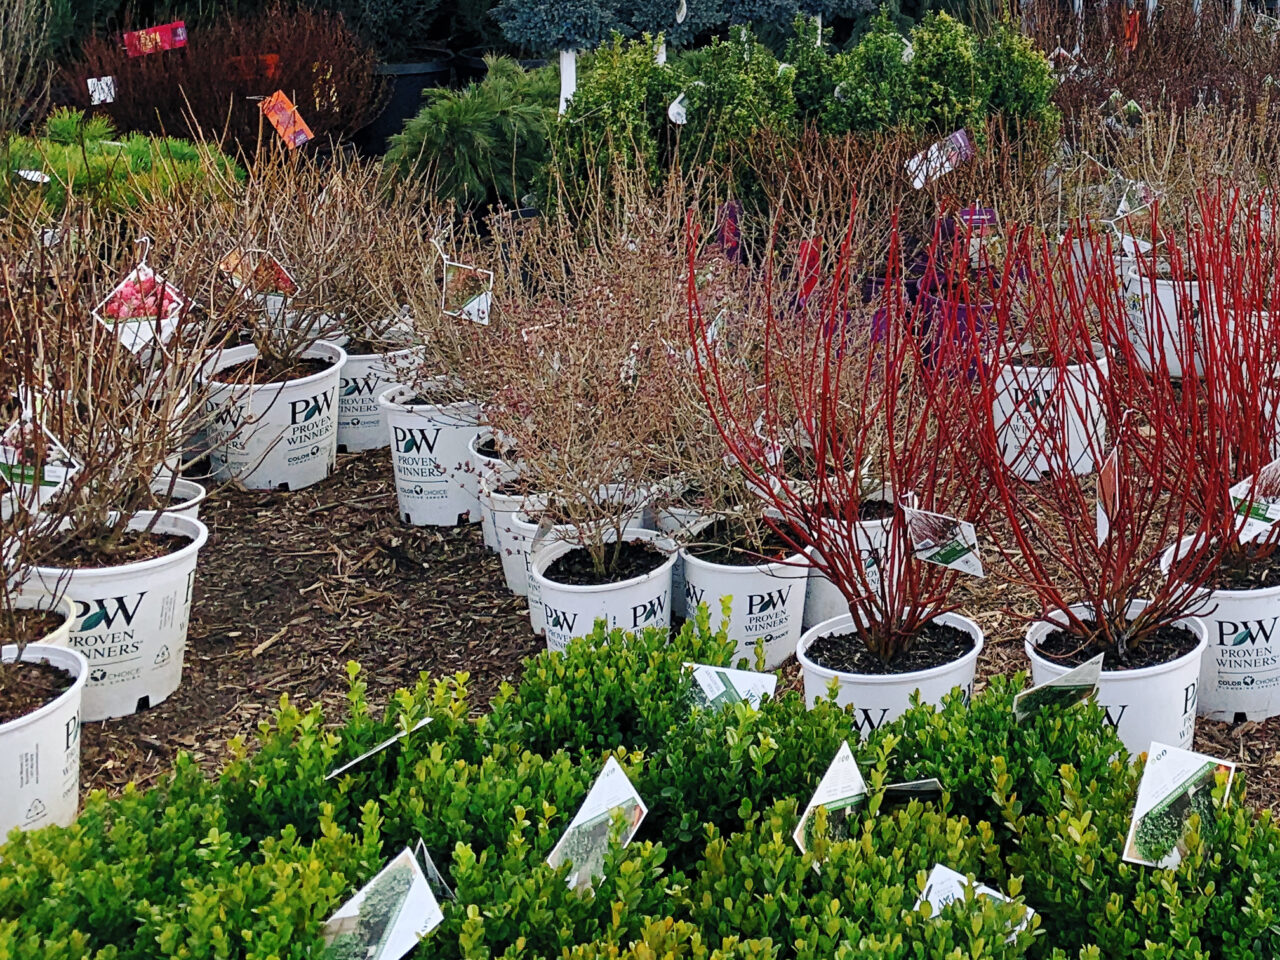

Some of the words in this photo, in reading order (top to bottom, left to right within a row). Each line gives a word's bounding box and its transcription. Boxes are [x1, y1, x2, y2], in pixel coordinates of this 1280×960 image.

[287, 386, 335, 426] PW
[339, 405, 379, 413] INNERS
[392, 425, 442, 455] PW
[398, 455, 438, 467] PROVEN
[746, 584, 792, 616] PW
[544, 602, 578, 634] PW
[631, 590, 667, 629] PW
[749, 609, 787, 624] PROVEN
[745, 615, 791, 632] WINNERS
[1215, 616, 1280, 647] PW
[69, 629, 135, 647] ROVEN
[80, 642, 141, 660] NNERS
[1221, 646, 1273, 658] PROVEN
[1216, 656, 1278, 669] WINNERS
[1217, 679, 1242, 687] COLOR
[1255, 676, 1280, 686] CHOICE
